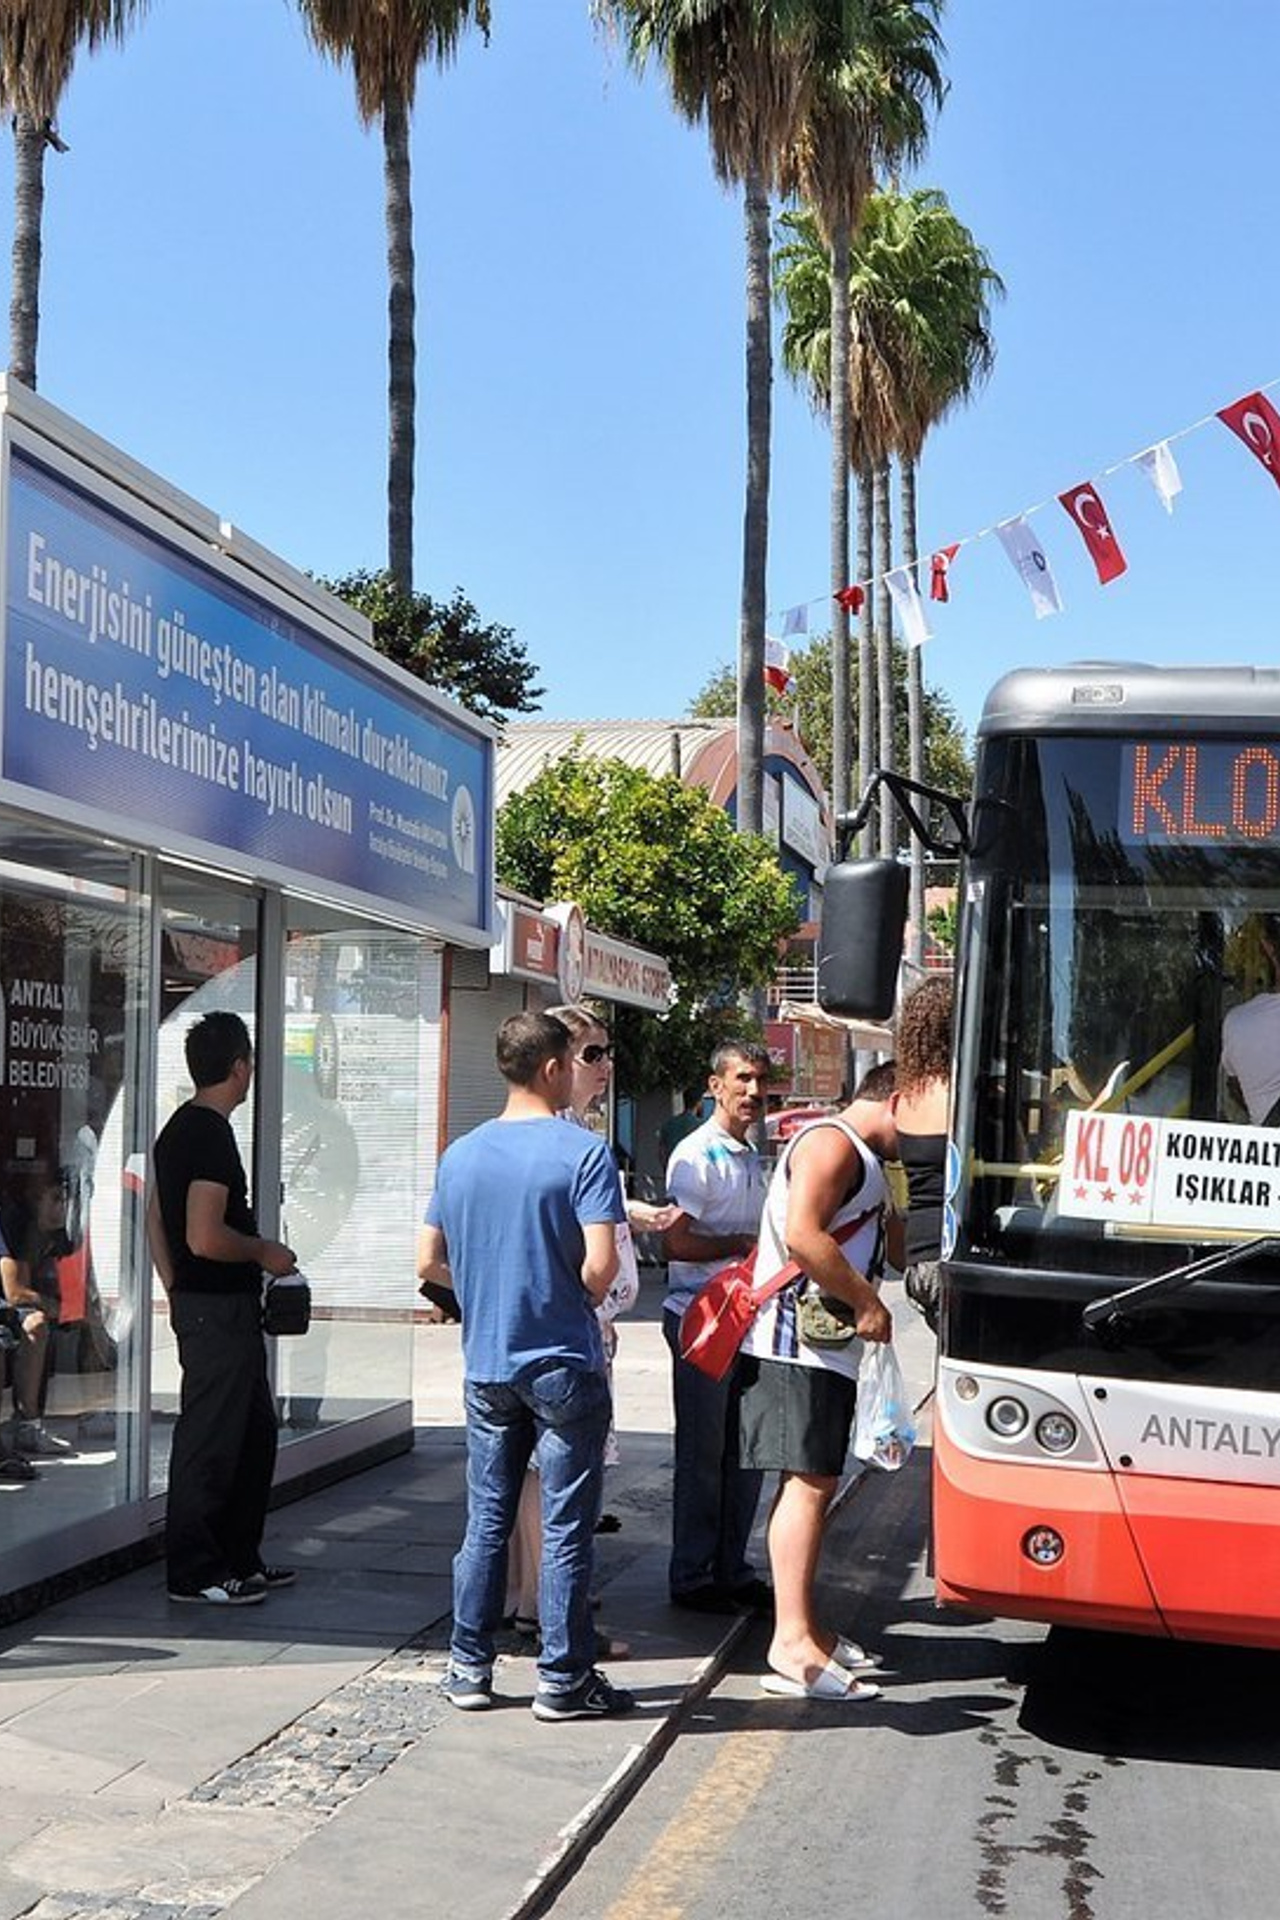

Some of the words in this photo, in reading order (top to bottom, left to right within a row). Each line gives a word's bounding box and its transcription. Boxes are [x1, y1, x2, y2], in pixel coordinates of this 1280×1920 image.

[28, 531, 151, 657] Enerjisini
[157, 609, 256, 708] güneşten
[260, 666, 300, 730] alan
[302, 683, 360, 759] klimalı
[362, 717, 449, 802] duraklarımız
[25, 641, 240, 791] hemşehrilerimize
[244, 740, 302, 816] hayırlı
[306, 773, 352, 834] olsun
[10, 979, 80, 1012] ANTALYA
[1073, 1117, 1109, 1183] KL
[1118, 1120, 1154, 1187] 08
[1166, 1132, 1280, 1168] KONYAALT
[1176, 1173, 1271, 1207] IŞIKLAR
[1140, 1413, 1280, 1458] ANTALY
